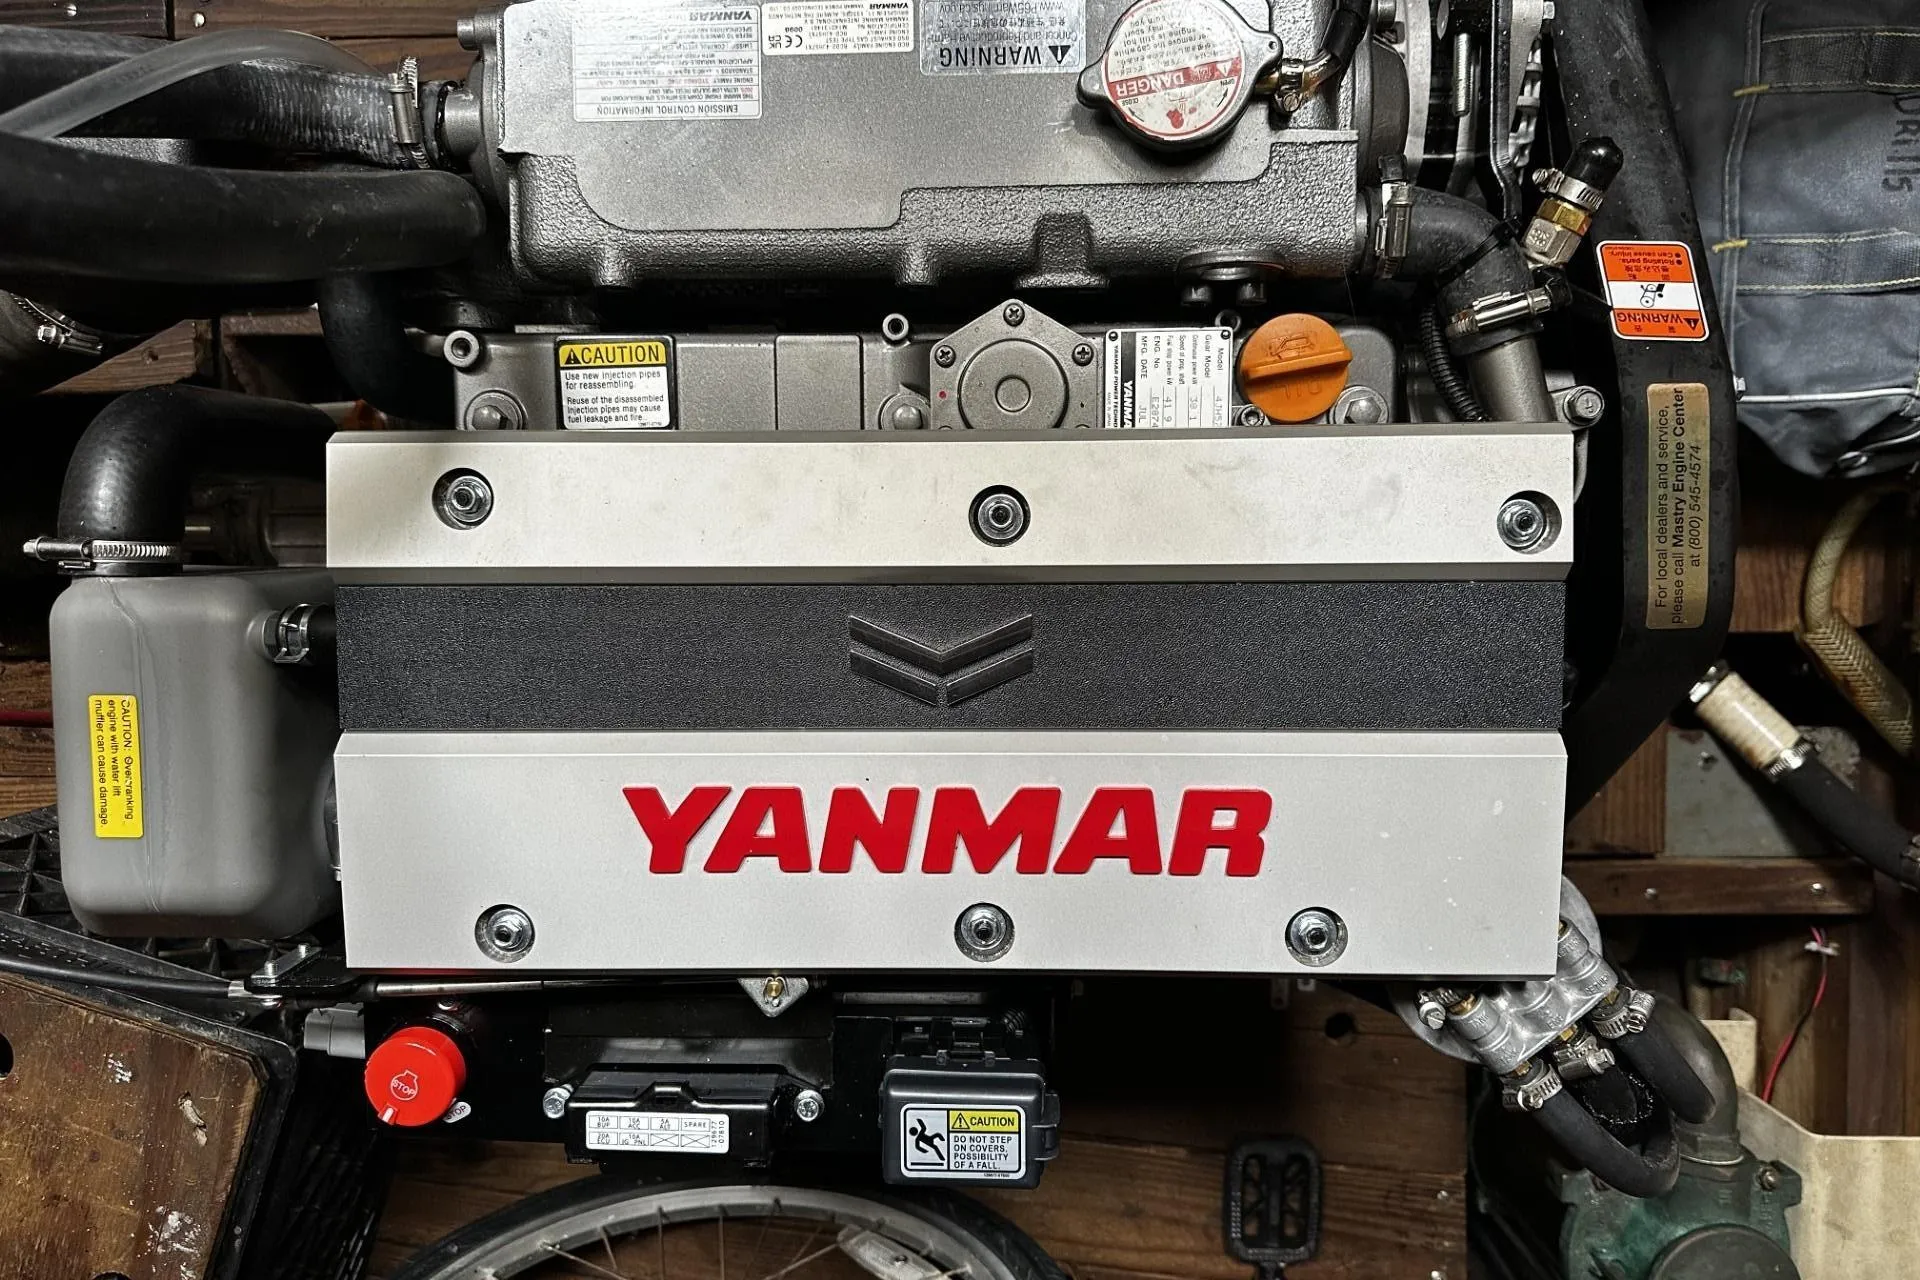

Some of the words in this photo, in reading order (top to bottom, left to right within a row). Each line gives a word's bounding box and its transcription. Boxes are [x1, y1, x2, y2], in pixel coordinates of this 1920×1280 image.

[689, 11, 752, 21] YANMAR
[784, 34, 803, 48] CE
[1140, 35, 1154, 45] still
[1168, 36, 1196, 47] remove
[939, 45, 1041, 67] WARNING
[1115, 71, 1185, 97] DANGER
[597, 105, 653, 115] INFORMATION
[657, 105, 695, 114] CONTROL
[698, 104, 738, 114] EMISSION
[1121, 97, 1139, 106] CLOSE
[1617, 312, 1683, 324] WARNING
[581, 345, 660, 364] CAUTION
[565, 372, 580, 380] Use
[583, 372, 599, 380] new
[602, 370, 637, 380] injection
[640, 370, 661, 379] pipes
[1140, 359, 1148, 379] DATE
[566, 381, 577, 390] for
[567, 396, 589, 405] Reuse
[591, 396, 598, 404] of
[601, 395, 612, 404] the
[615, 394, 664, 403] disassembled
[601, 405, 620, 414] pipes
[1139, 405, 1147, 423] JUL
[1672, 388, 1685, 437] Center
[584, 415, 613, 423] leakage
[1657, 405, 1670, 458] service,
[1655, 463, 1669, 489] and
[1672, 442, 1687, 493] Engine
[1689, 445, 1701, 512] 545-4574
[1655, 494, 1668, 544] dealers
[1672, 498, 1686, 547] Mastry
[1688, 516, 1703, 550] (800)
[1655, 549, 1668, 579] local
[1671, 552, 1684, 575] call
[1690, 554, 1701, 567] at
[1655, 585, 1668, 607] For
[1671, 580, 1685, 624] please
[95, 700, 105, 733] muffler
[107, 700, 118, 732] engine
[121, 700, 132, 751] CAUTION:
[97, 735, 105, 753] can
[110, 735, 120, 754] with
[97, 755, 107, 784] cause
[111, 757, 120, 782] water
[112, 785, 122, 797] lift
[98, 787, 109, 827] damage.
[623, 786, 1273, 877] YANMAR
[392, 1079, 416, 1095] STOP
[446, 1105, 466, 1119] STOP
[970, 1117, 1015, 1126] CAUTION
[954, 1144, 966, 1152] ON
[990, 1136, 1012, 1144] STEP
[954, 1153, 1008, 1161] POSSIBILITY
[954, 1161, 965, 1169] OF
[968, 1161, 974, 1169] A
[977, 1162, 1000, 1170] FALL.
